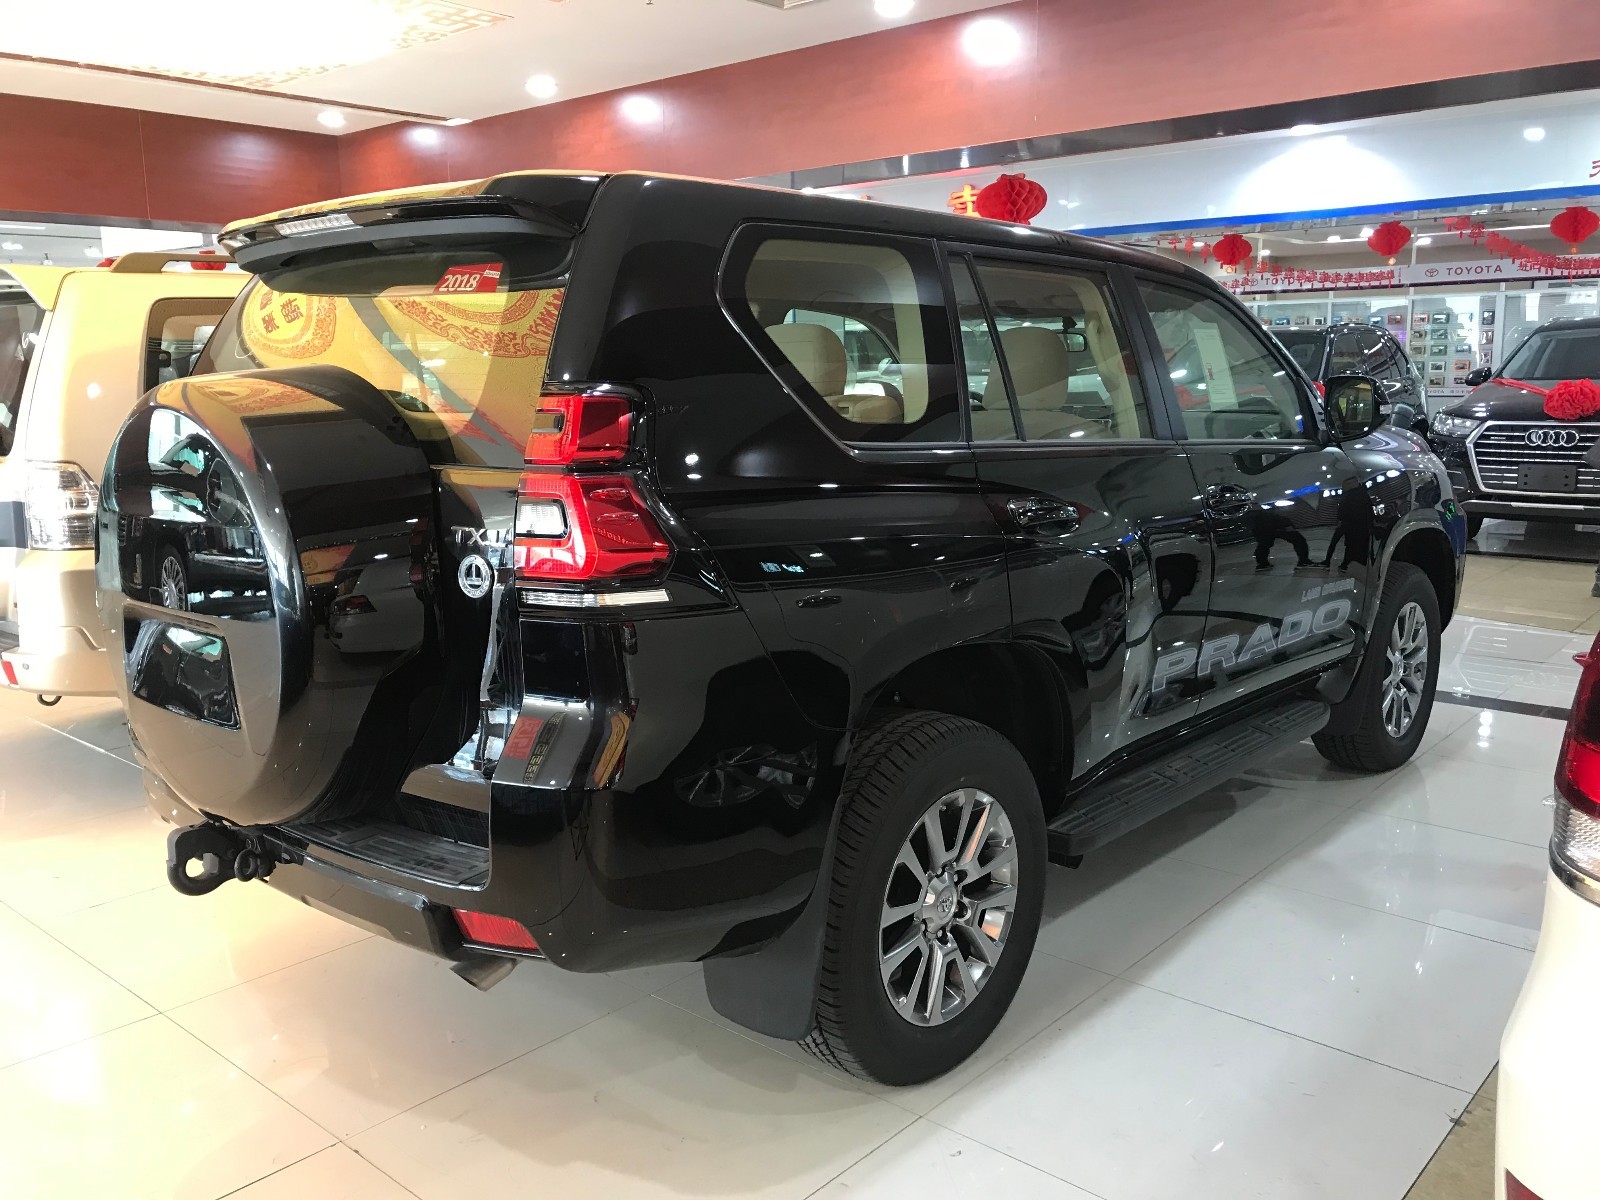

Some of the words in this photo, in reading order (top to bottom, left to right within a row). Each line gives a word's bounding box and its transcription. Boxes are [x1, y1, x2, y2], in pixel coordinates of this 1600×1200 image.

[1446, 264, 1503, 276] TOYOTA
[439, 274, 480, 291] 2018
[1151, 599, 1351, 692] PRADO
